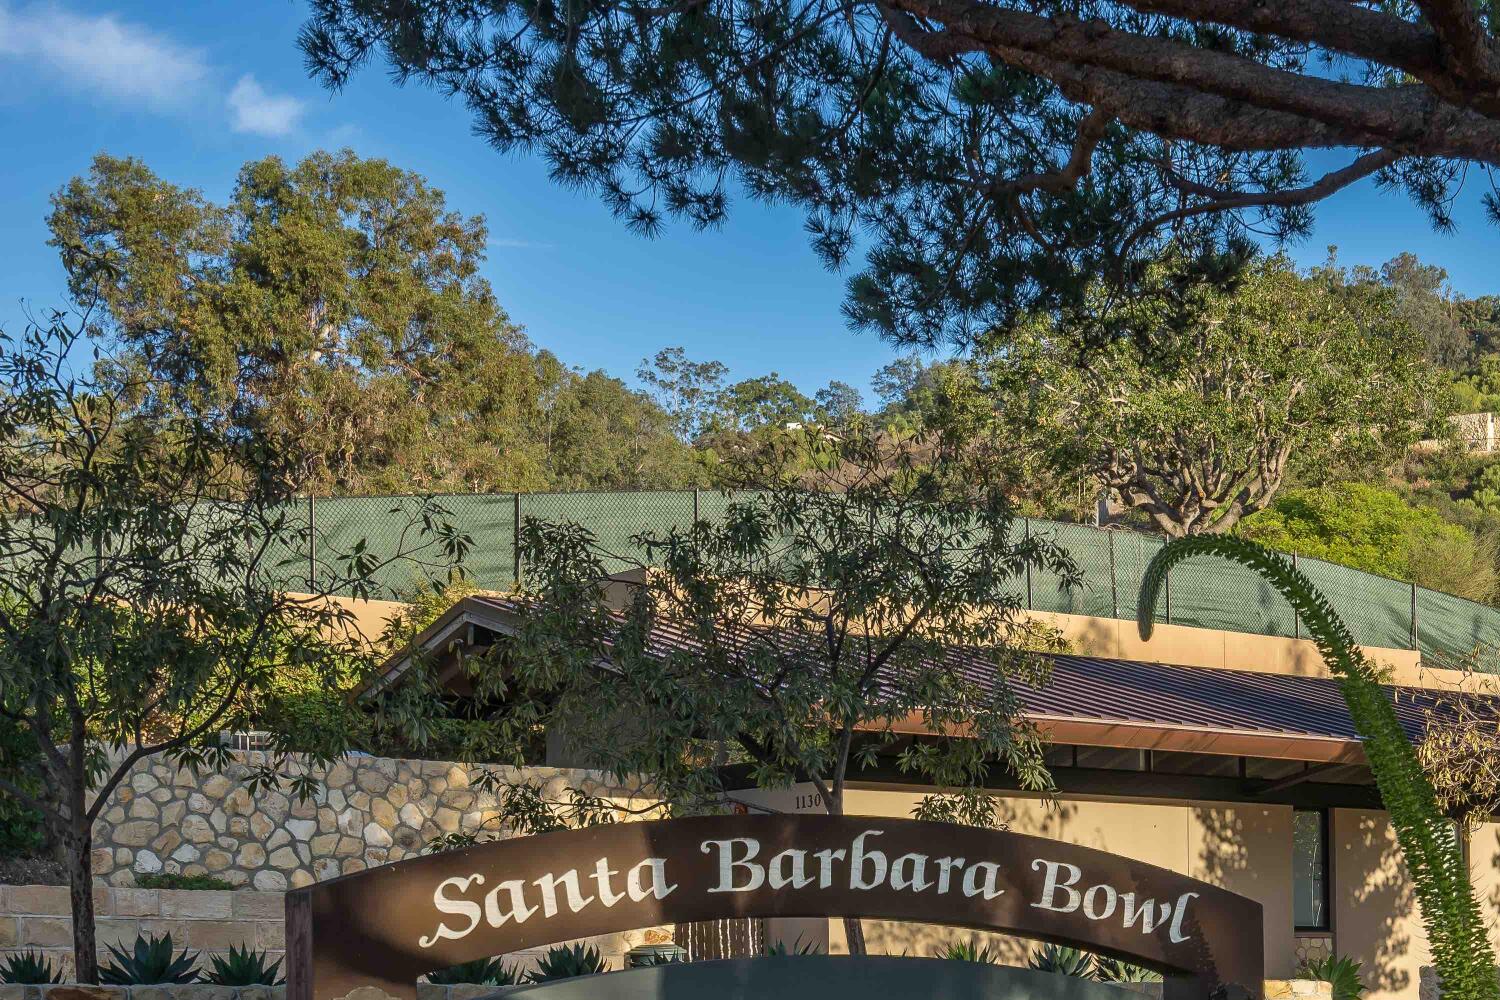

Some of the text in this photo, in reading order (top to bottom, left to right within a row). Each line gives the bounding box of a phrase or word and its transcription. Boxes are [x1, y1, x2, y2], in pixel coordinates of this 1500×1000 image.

[795, 793, 821, 809] 1130
[418, 829, 1200, 948] Santa Barbara Bowl
